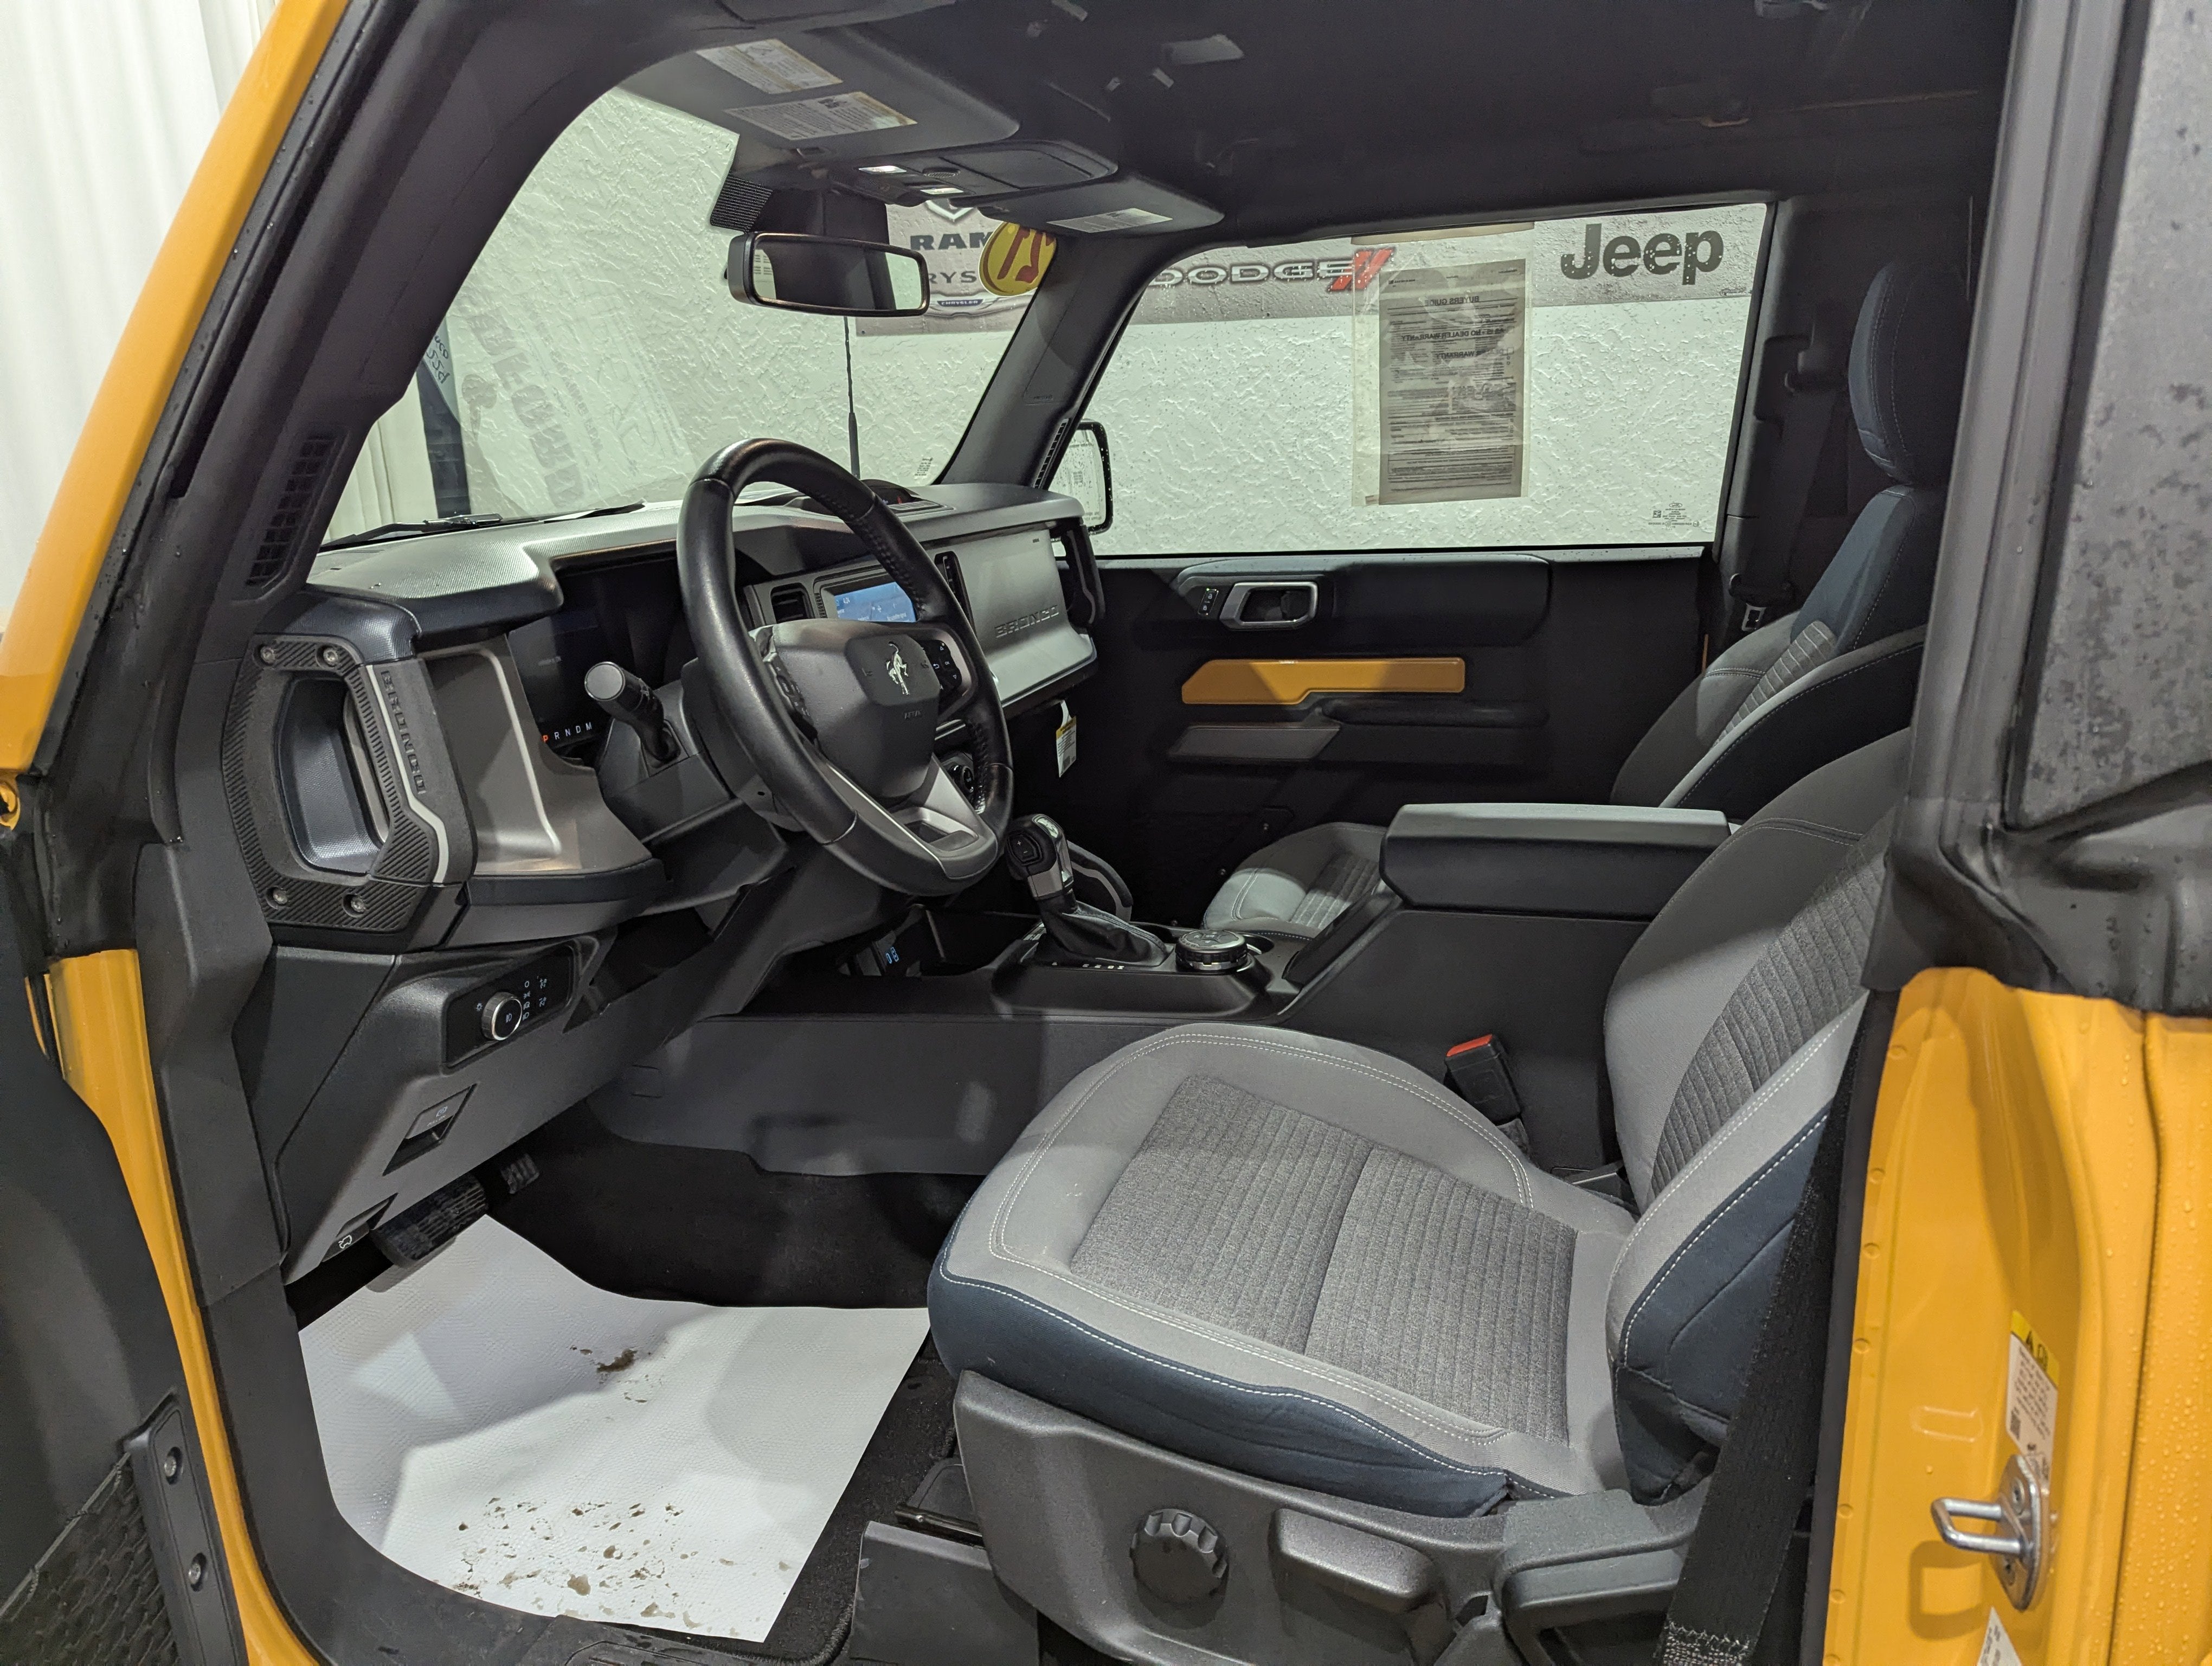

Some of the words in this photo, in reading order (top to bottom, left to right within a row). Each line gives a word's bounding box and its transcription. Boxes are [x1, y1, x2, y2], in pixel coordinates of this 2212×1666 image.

[1560, 223, 1724, 285] Jeep
[994, 604, 1059, 638] BRONCO
[381, 670, 427, 794] BRONCO
[543, 734, 549, 743] P
[554, 732, 560, 740] R
[565, 728, 571, 737] N
[575, 725, 581, 734] D
[586, 722, 592, 731] M
